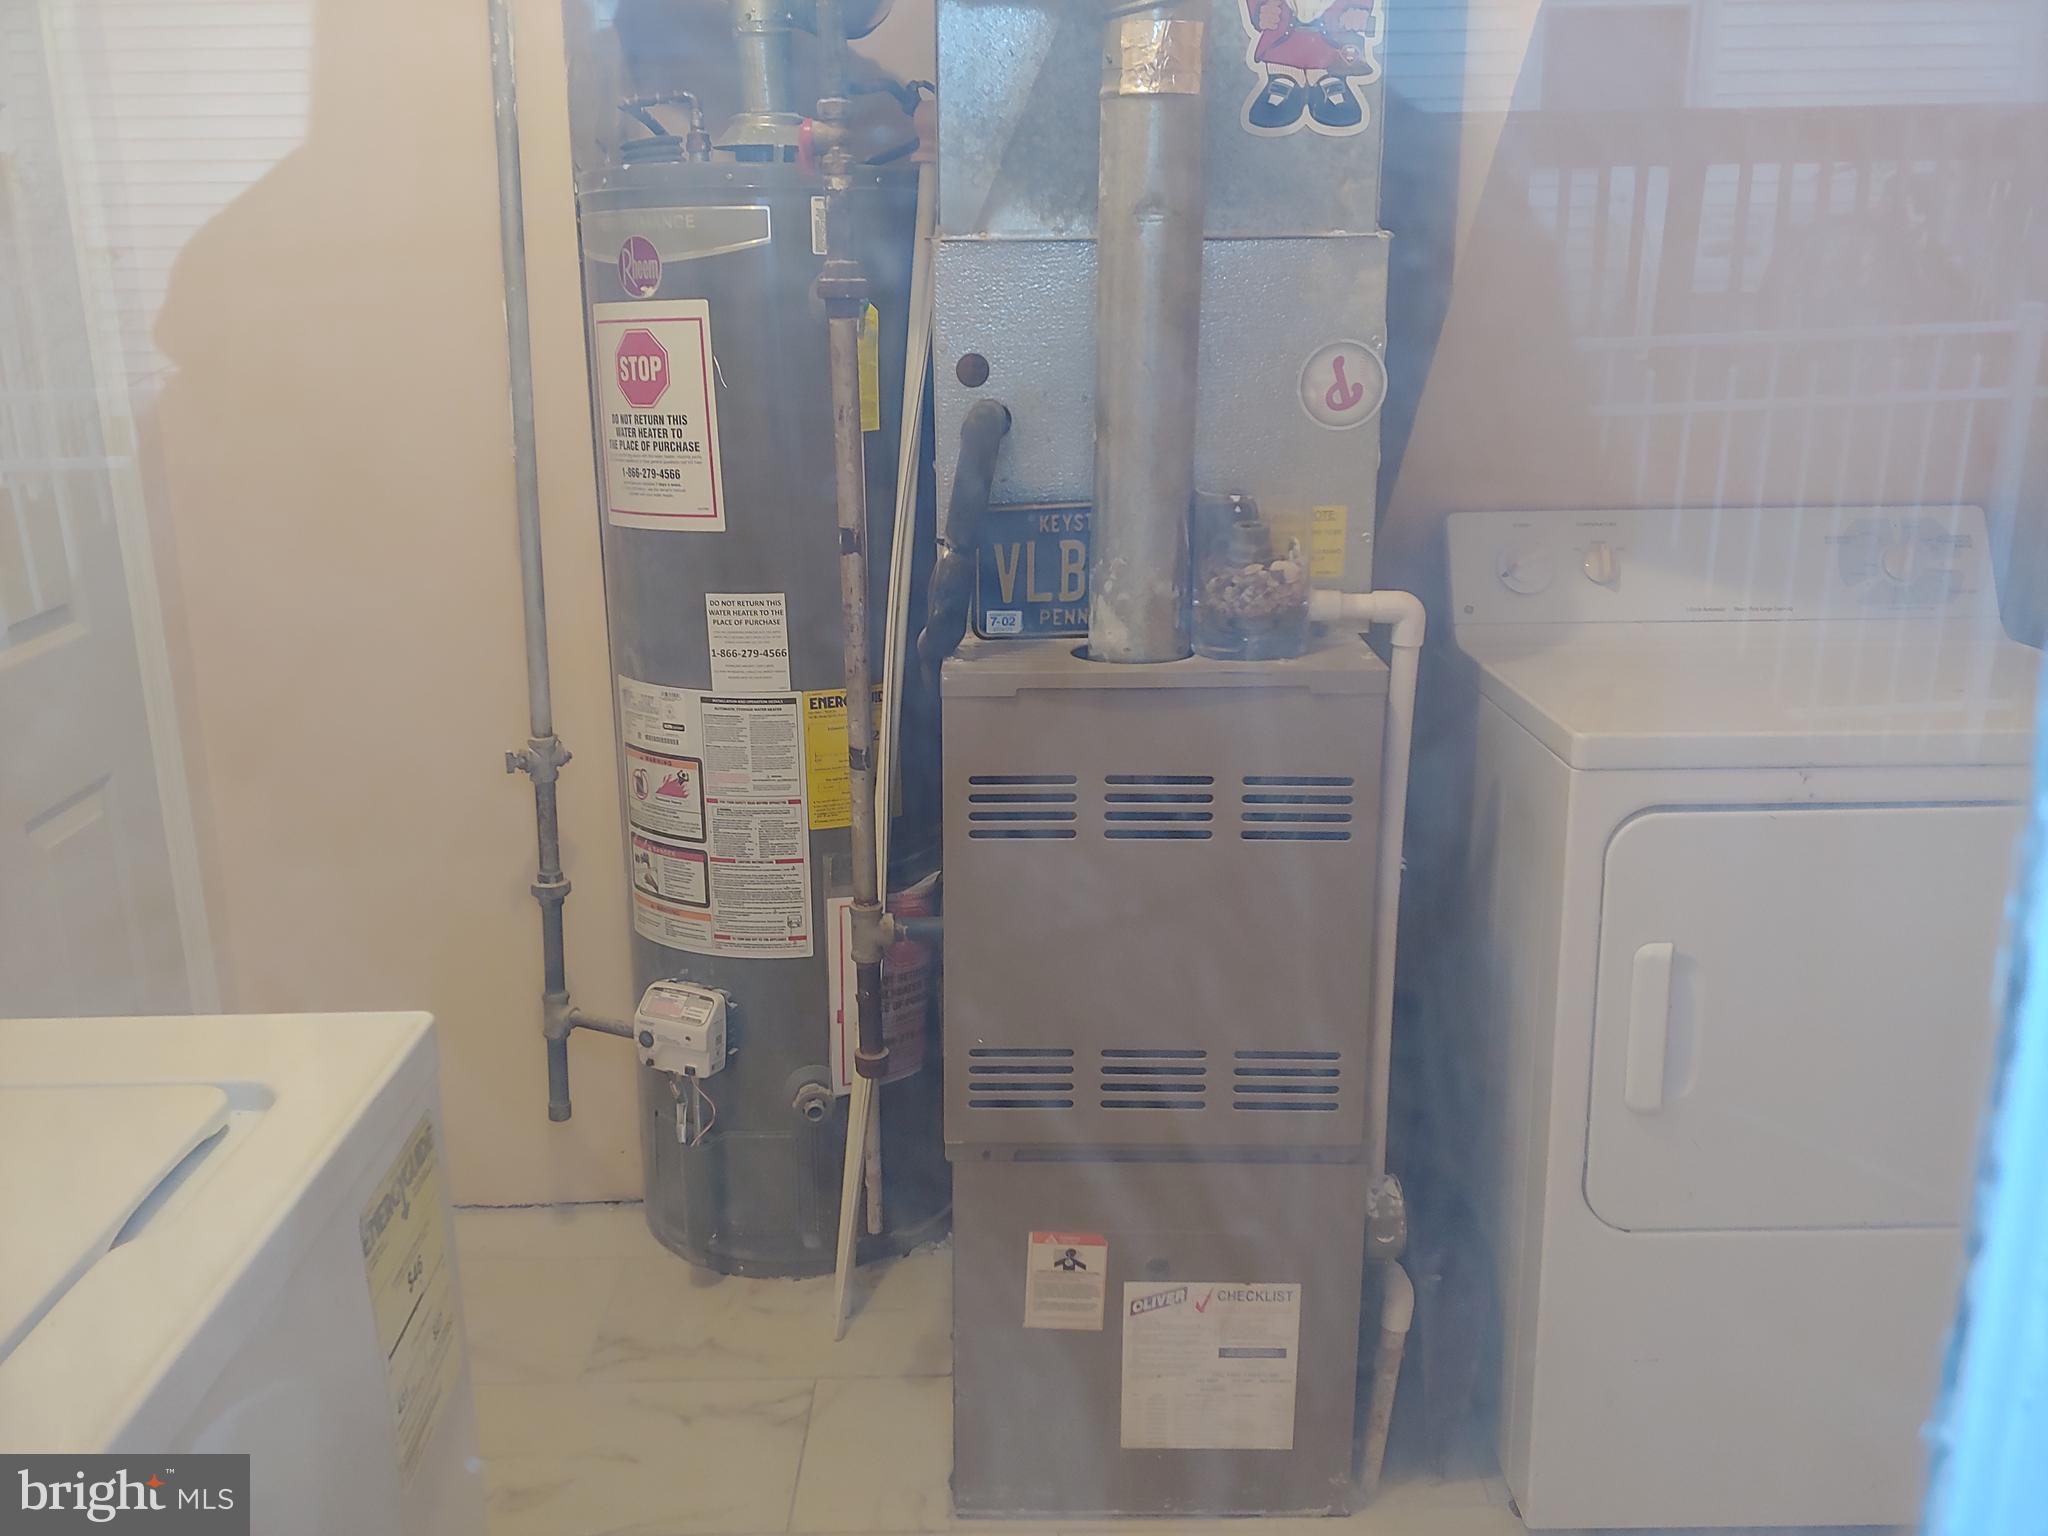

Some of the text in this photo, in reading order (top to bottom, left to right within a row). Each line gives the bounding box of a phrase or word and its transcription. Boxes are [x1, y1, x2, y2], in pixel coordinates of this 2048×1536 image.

[622, 236, 659, 288] Rheem
[619, 355, 662, 383] STOP
[620, 413, 632, 425] NOT
[634, 414, 665, 425] RETURN
[667, 415, 688, 426] THIS
[615, 426, 683, 439] WATER HEATER TO
[619, 440, 639, 451] PLACE
[641, 441, 651, 451] OF
[653, 441, 700, 452] PURCHASE
[622, 467, 681, 480] 1-866-279-4566
[994, 539, 1087, 604] VLB
[708, 609, 784, 617] WATER HEATER TO THE
[711, 648, 788, 658] 1-866-279-4566
[1131, 1287, 1294, 1314] OLIVER CHECKLIST
